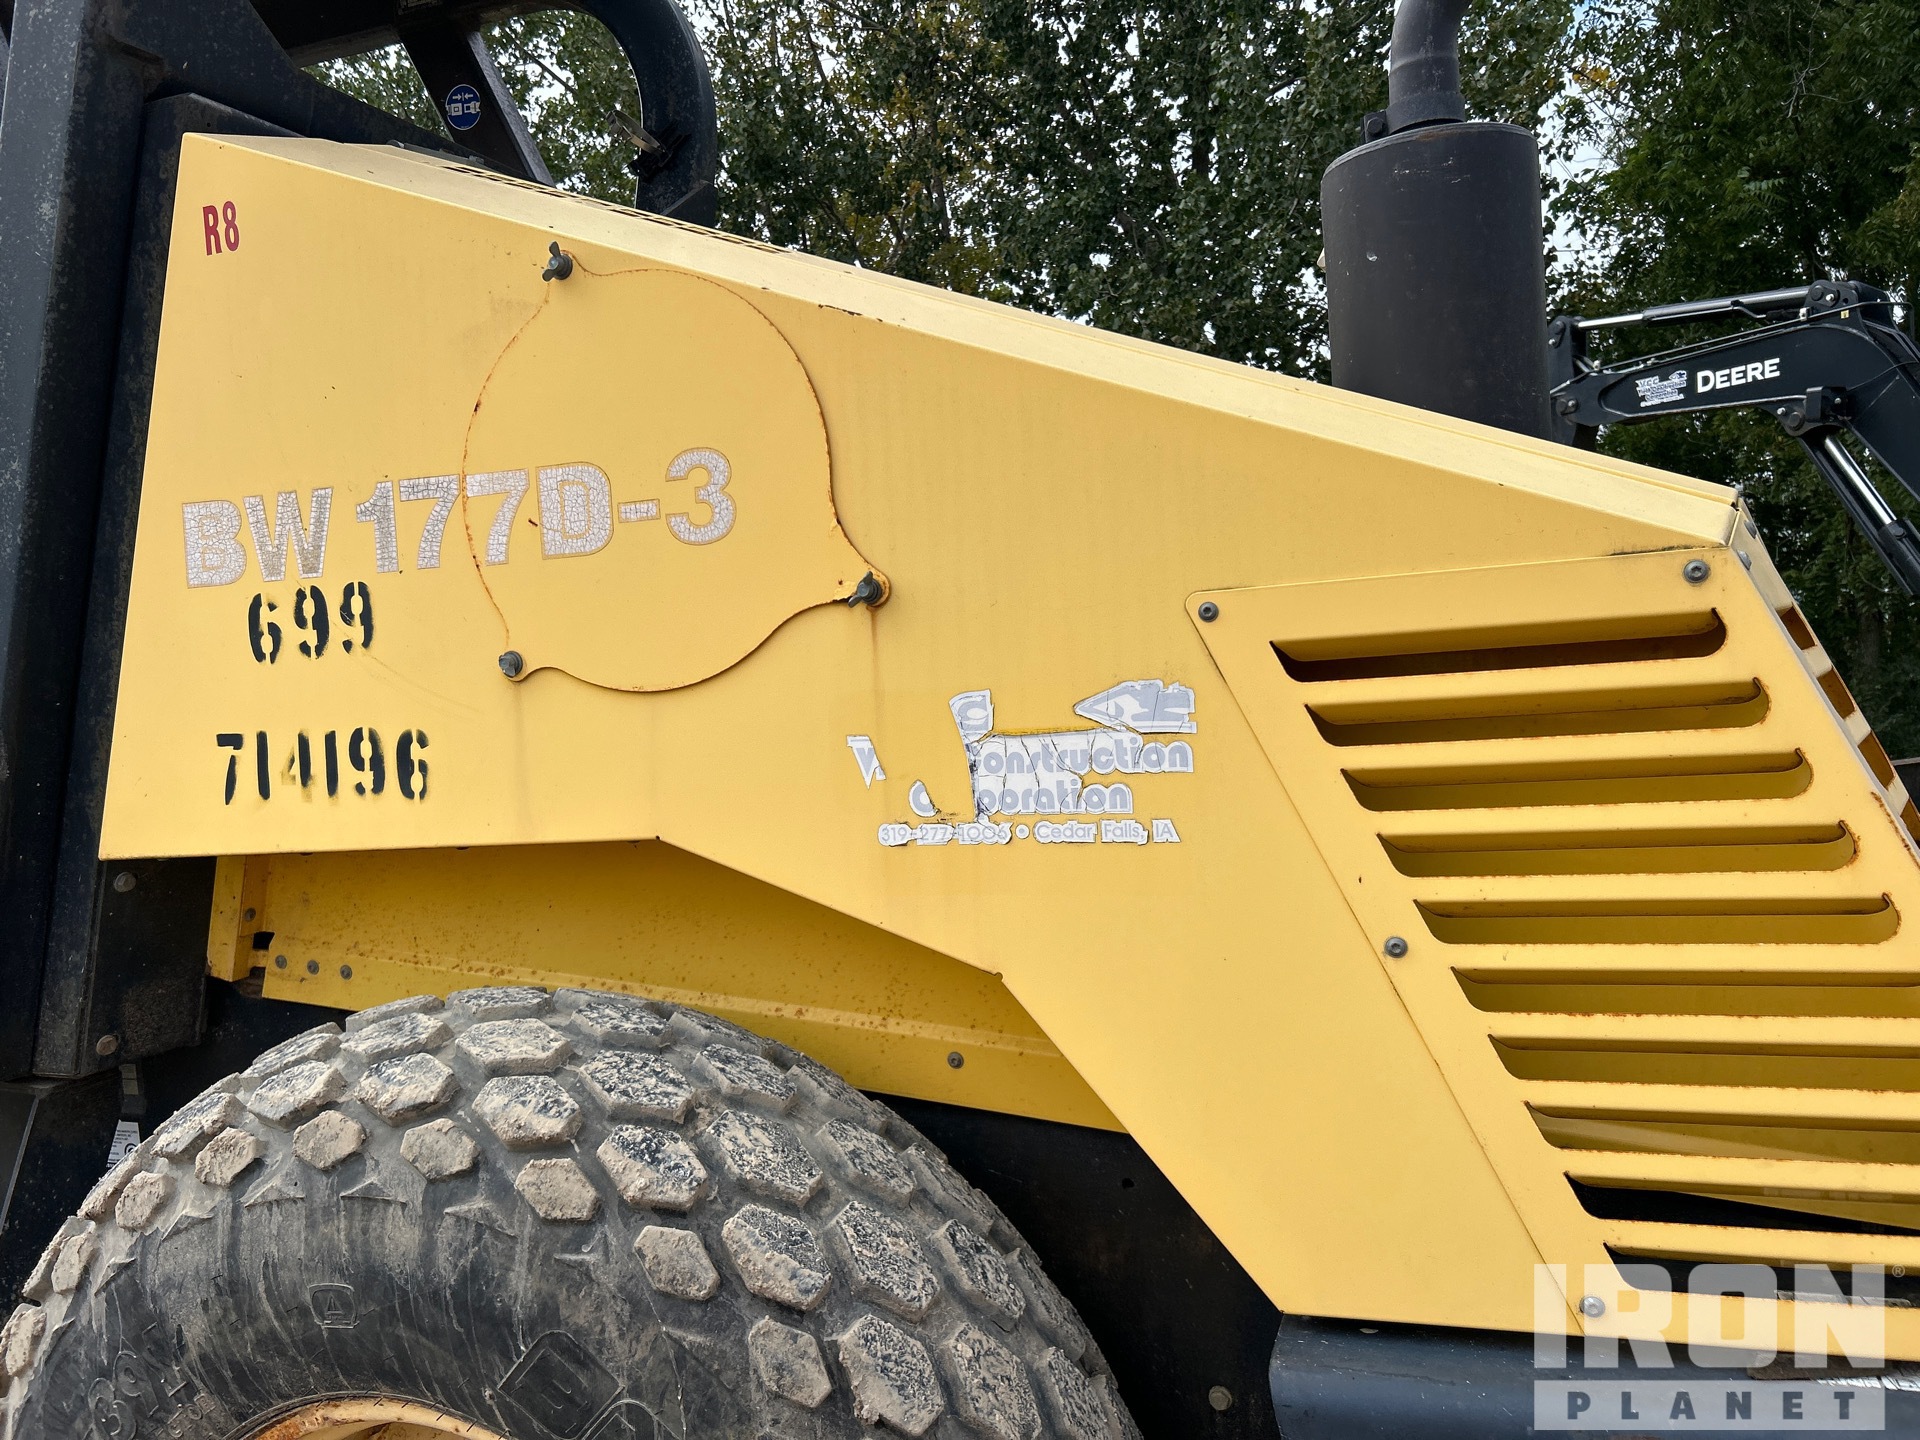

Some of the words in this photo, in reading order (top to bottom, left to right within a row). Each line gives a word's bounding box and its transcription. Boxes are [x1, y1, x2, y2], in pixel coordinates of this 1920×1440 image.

[202, 200, 240, 256] R8
[1696, 357, 1781, 394] DEERE
[182, 487, 334, 589] BW
[355, 447, 737, 574] 177D-3
[248, 581, 374, 665] 699
[1035, 822, 1093, 840] Cedar
[1103, 822, 1145, 841] Falls,
[1156, 822, 1178, 839] IA
